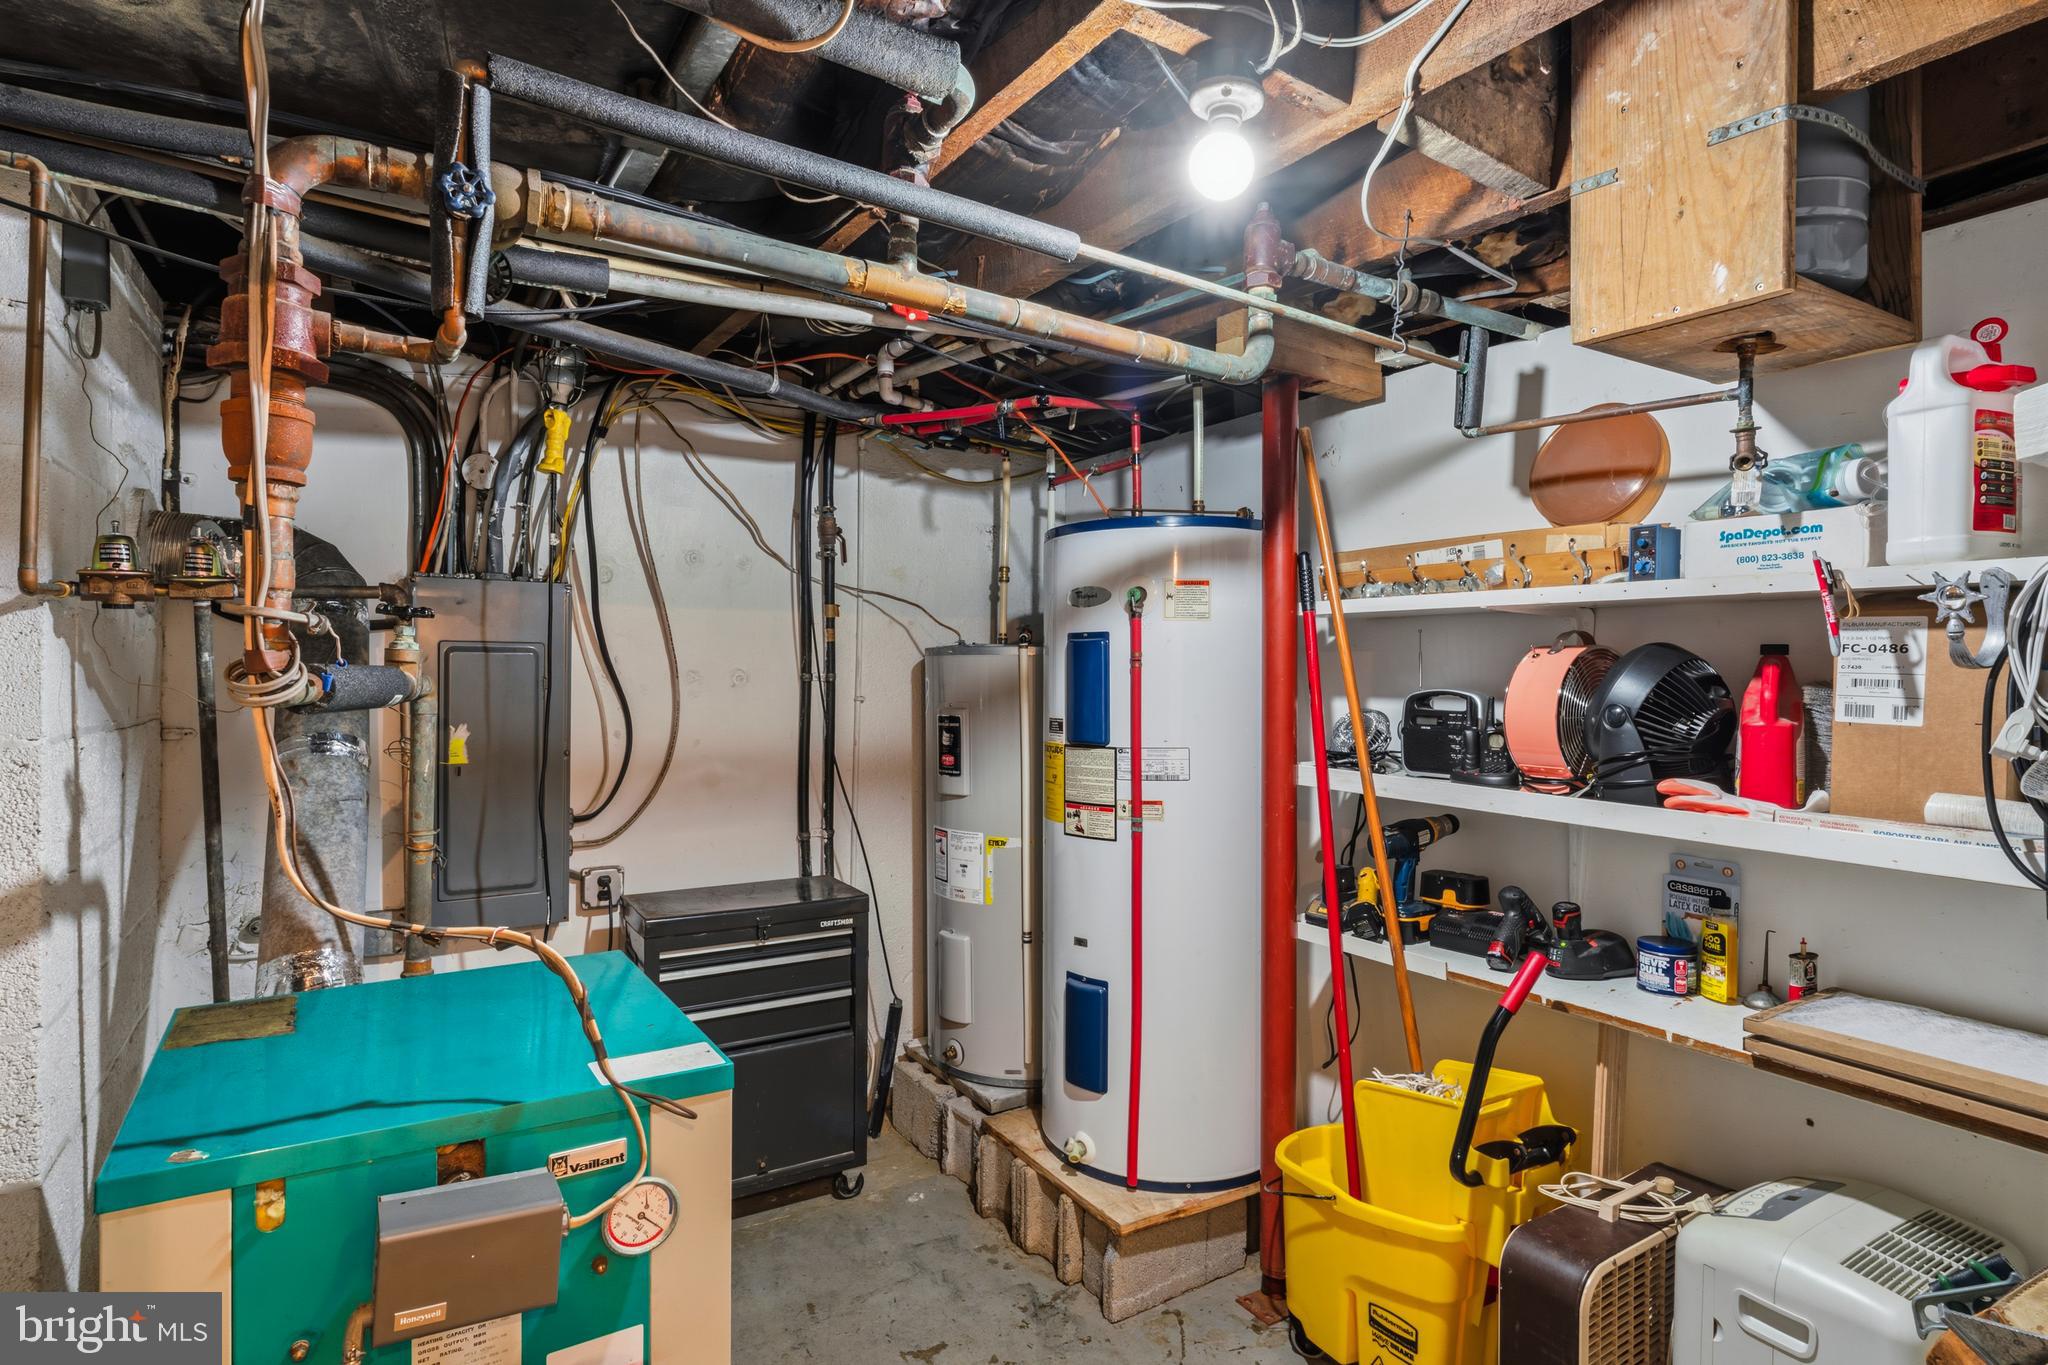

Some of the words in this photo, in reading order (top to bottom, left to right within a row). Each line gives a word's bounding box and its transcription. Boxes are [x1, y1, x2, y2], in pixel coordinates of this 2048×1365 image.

[1719, 523, 1823, 543] SpaDepot.com
[1842, 643, 1909, 654] FC-0486
[1669, 899, 1691, 911] LATEX
[569, 1152, 625, 1173] Vaillant
[400, 1309, 441, 1326] Honeywell
[417, 1336, 443, 1347] HEATING
[446, 1326, 475, 1339] CAPACITY
